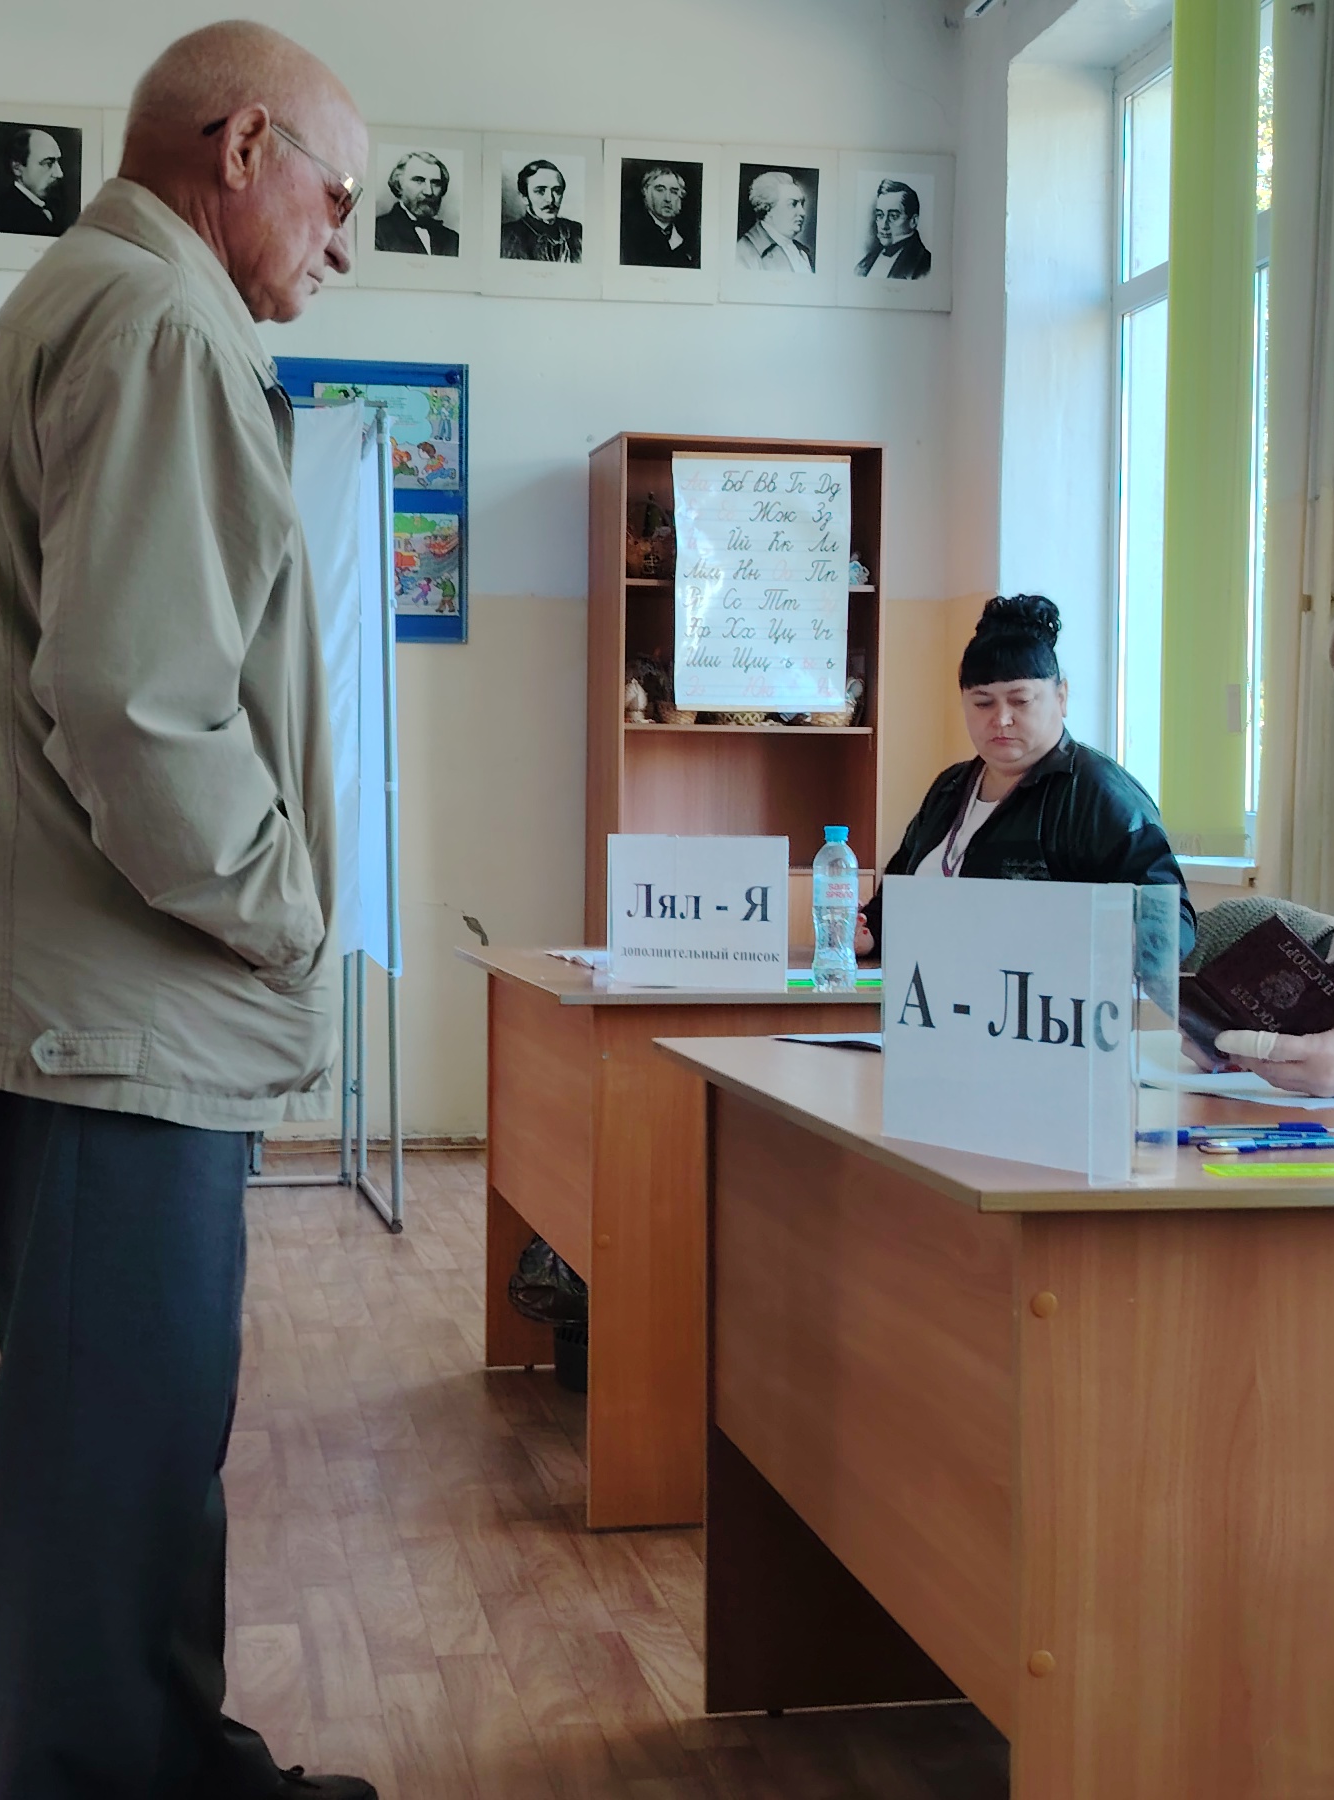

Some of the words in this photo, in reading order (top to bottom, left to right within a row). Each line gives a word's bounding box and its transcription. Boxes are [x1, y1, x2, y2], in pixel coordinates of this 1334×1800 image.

[722, 470, 753, 492] Бб
[753, 472, 778, 493] Вв
[785, 471, 807, 494] Гг
[814, 473, 841, 502] Дд
[749, 501, 797, 523] Жж
[812, 502, 834, 531] Зз
[768, 530, 794, 552] Кк
[808, 532, 839, 552] Лл
[733, 559, 761, 580] Нн
[805, 560, 838, 582] Пп
[722, 588, 742, 609] Сс
[758, 589, 800, 610] Тт
[722, 617, 756, 639] Хх
[768, 618, 796, 644] Цц
[811, 618, 833, 640] Чч
[686, 647, 722, 668] Шш
[732, 647, 770, 673] Щщ
[626, 883, 702, 920] Лял
[740, 885, 773, 922] Я
[620, 947, 729, 961] дополнительный
[733, 950, 780, 963] список
[897, 961, 936, 1029] А
[953, 1003, 971, 1016] -
[988, 968, 1120, 1053] Лыс
